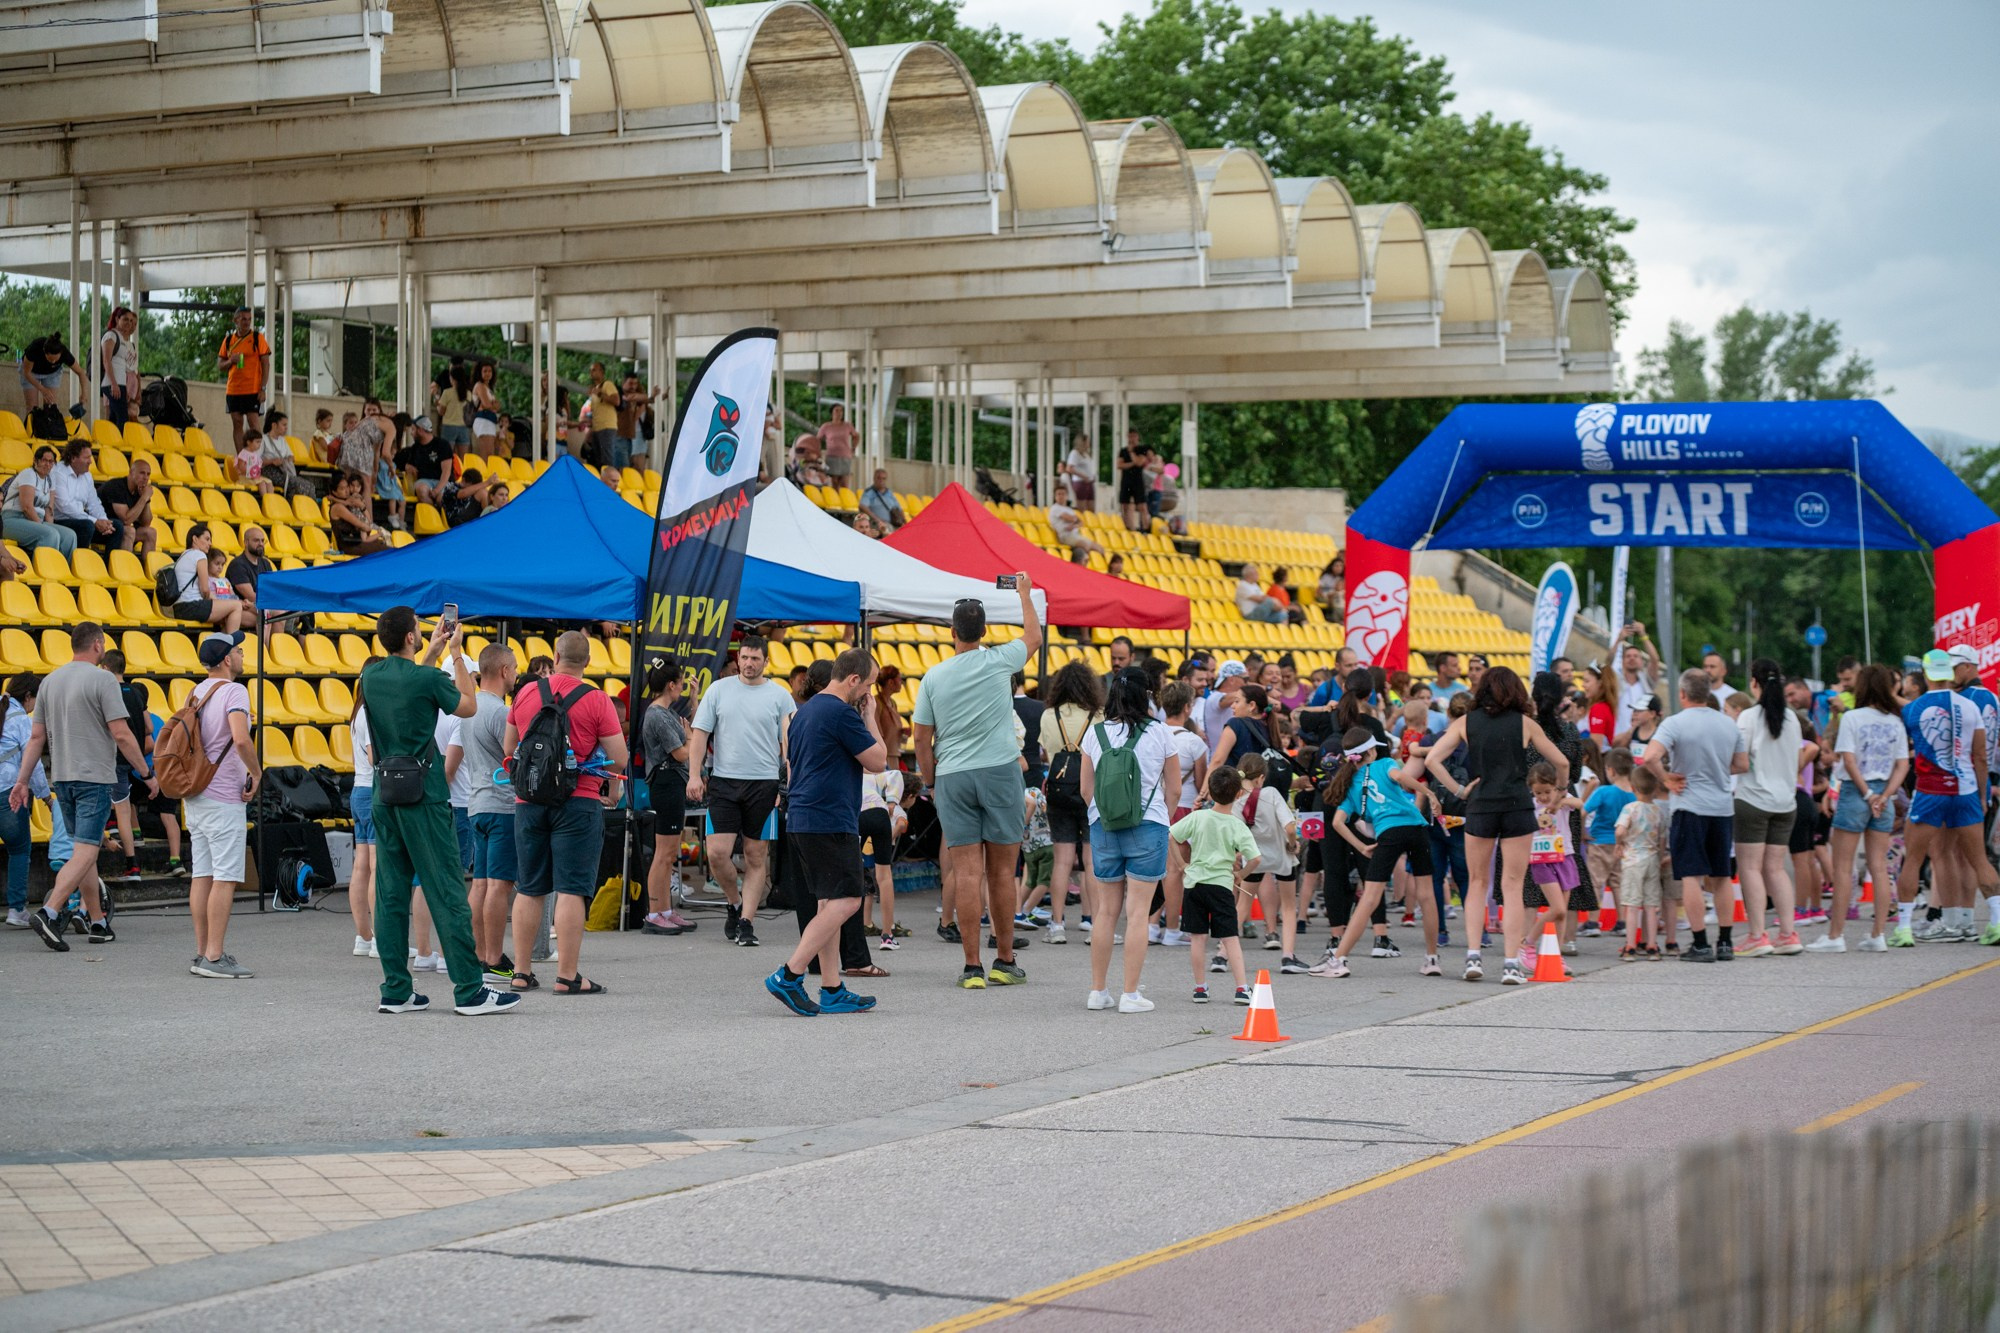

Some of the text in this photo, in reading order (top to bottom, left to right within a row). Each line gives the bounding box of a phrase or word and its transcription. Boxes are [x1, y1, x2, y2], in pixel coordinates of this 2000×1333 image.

[1621, 414, 1712, 435] PLOVDIV
[1621, 440, 1680, 460] HILLS
[1588, 483, 1753, 536] START
[649, 592, 729, 639] ИГРИ
[677, 642, 691, 657] НА
[1534, 841, 1550, 851] 110
